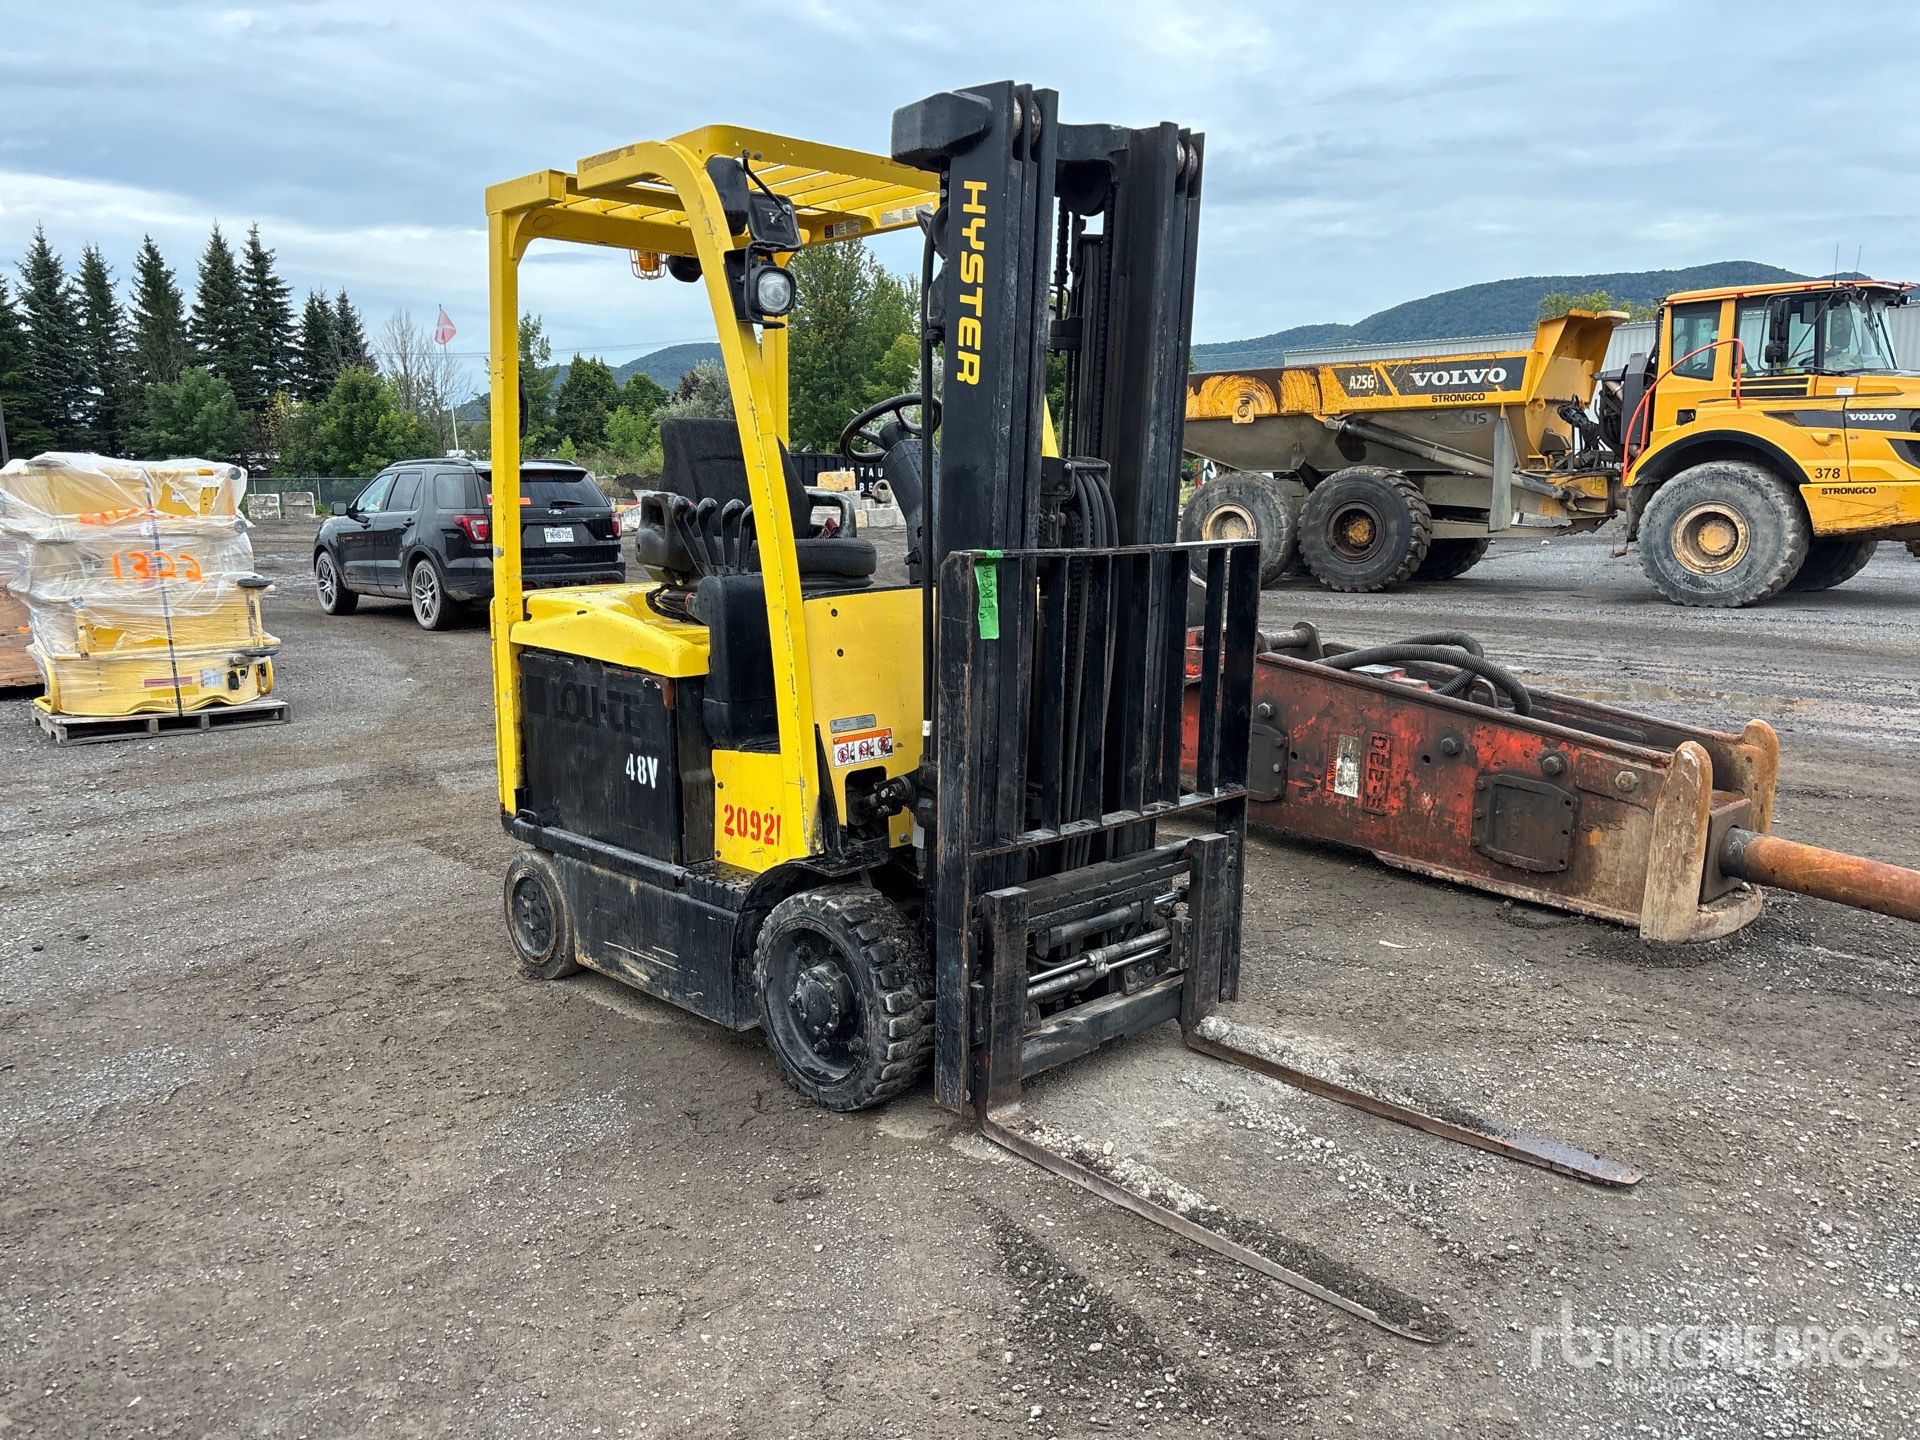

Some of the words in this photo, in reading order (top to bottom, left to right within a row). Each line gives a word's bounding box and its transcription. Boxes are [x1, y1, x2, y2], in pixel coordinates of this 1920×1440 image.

[956, 180, 987, 386] HYSTER
[1348, 374, 1375, 390] A25G
[1409, 367, 1508, 388] VOLVO
[1431, 393, 1486, 403] STRONGCO
[1848, 413, 1897, 421] VOLVO
[1814, 467, 1841, 480] 378
[1821, 486, 1877, 495] STRONGCO
[111, 551, 206, 583] 1322
[625, 753, 658, 789] 48V
[723, 804, 781, 847] 20921
